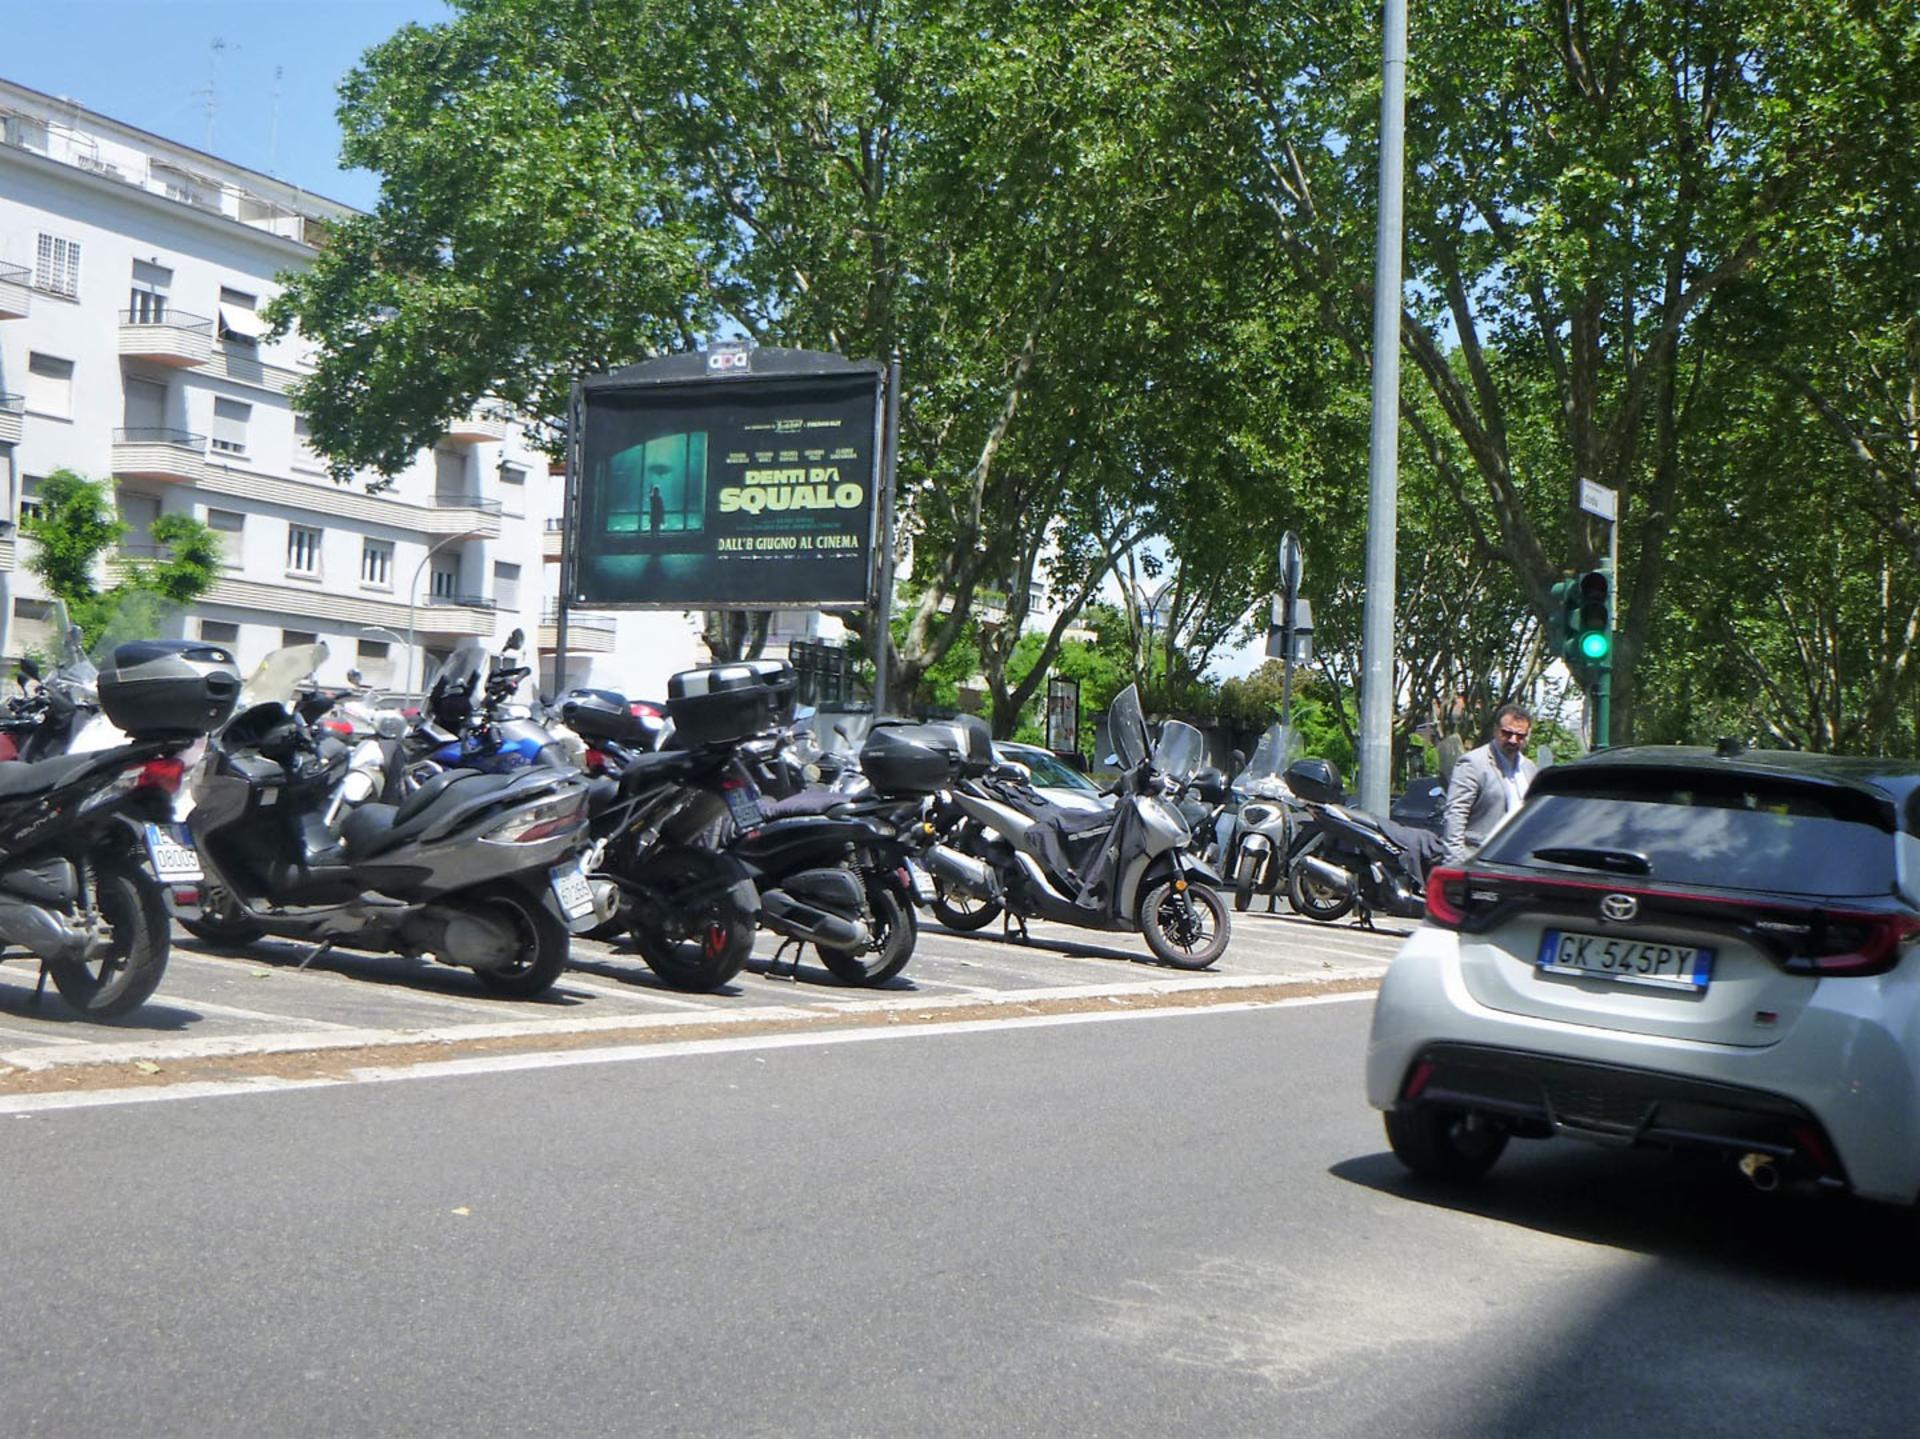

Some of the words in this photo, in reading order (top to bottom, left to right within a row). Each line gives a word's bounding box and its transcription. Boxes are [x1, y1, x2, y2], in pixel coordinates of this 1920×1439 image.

[745, 469, 806, 485] DENTI
[809, 467, 840, 483] DA
[719, 483, 863, 514] SQUALO
[755, 536, 797, 550] GIUGNO
[800, 536, 813, 549] AL
[816, 535, 859, 549] CINEMA
[1558, 936, 1593, 967] GK
[1602, 941, 1692, 979] 545PY
